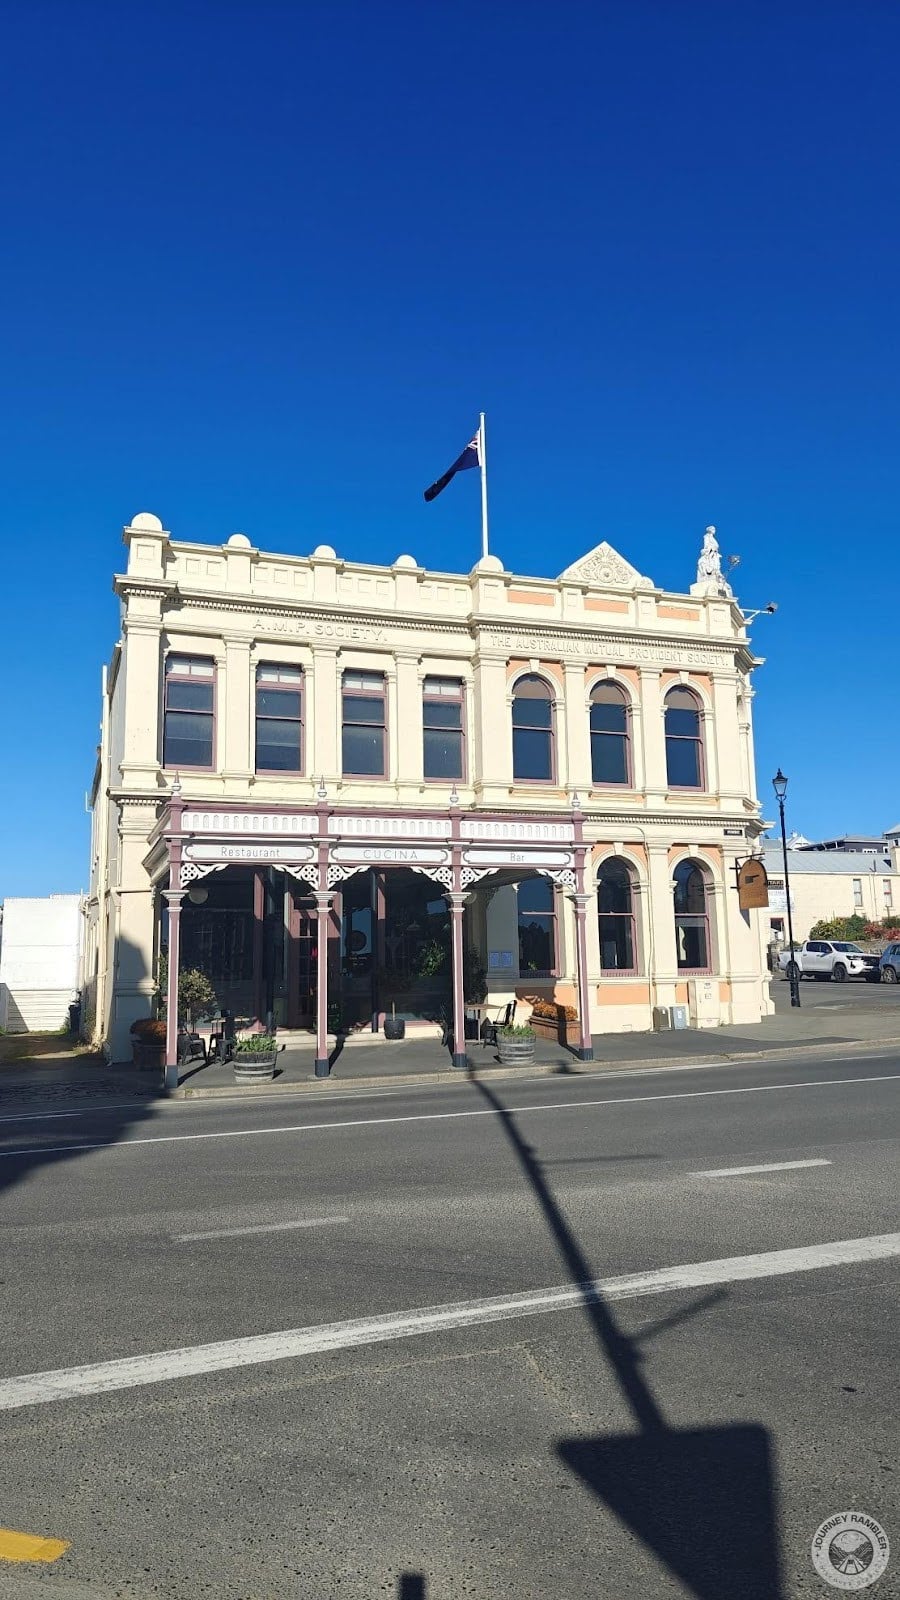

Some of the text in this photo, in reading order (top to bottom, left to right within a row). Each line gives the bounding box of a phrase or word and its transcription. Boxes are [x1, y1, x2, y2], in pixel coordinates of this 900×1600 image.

[315, 624, 387, 641] SOCIETY.
[490, 635, 511, 647] THE
[516, 638, 580, 653] AUSTRALIAN
[584, 643, 624, 657] MUTUAL
[629, 647, 683, 662] PROVIDENT
[221, 846, 280, 857] Restaurant
[363, 849, 418, 860] CUCINA
[510, 852, 525, 862] Bar
